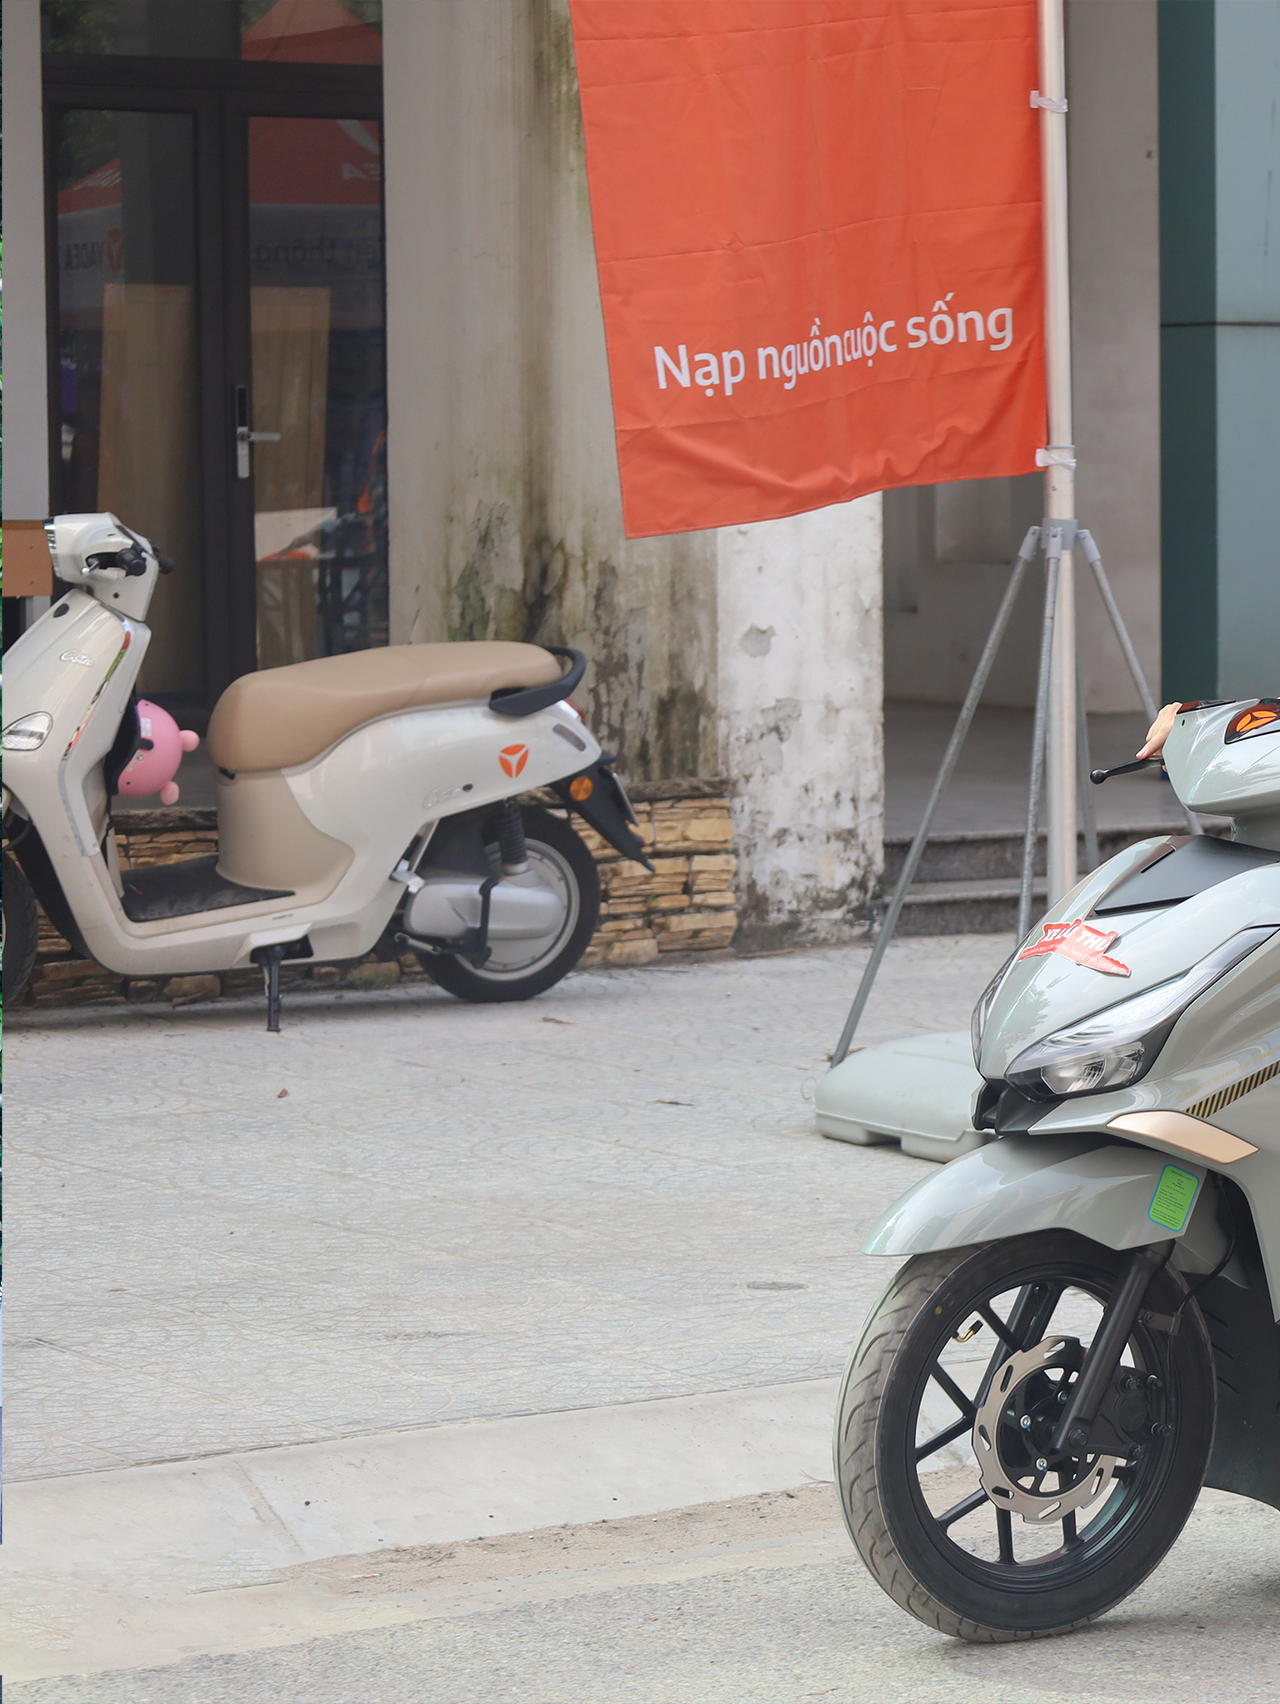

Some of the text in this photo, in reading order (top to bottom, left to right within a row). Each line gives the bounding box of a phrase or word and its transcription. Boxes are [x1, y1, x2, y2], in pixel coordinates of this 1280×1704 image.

[653, 292, 1014, 397] Nạp nguồn cuộc sống
